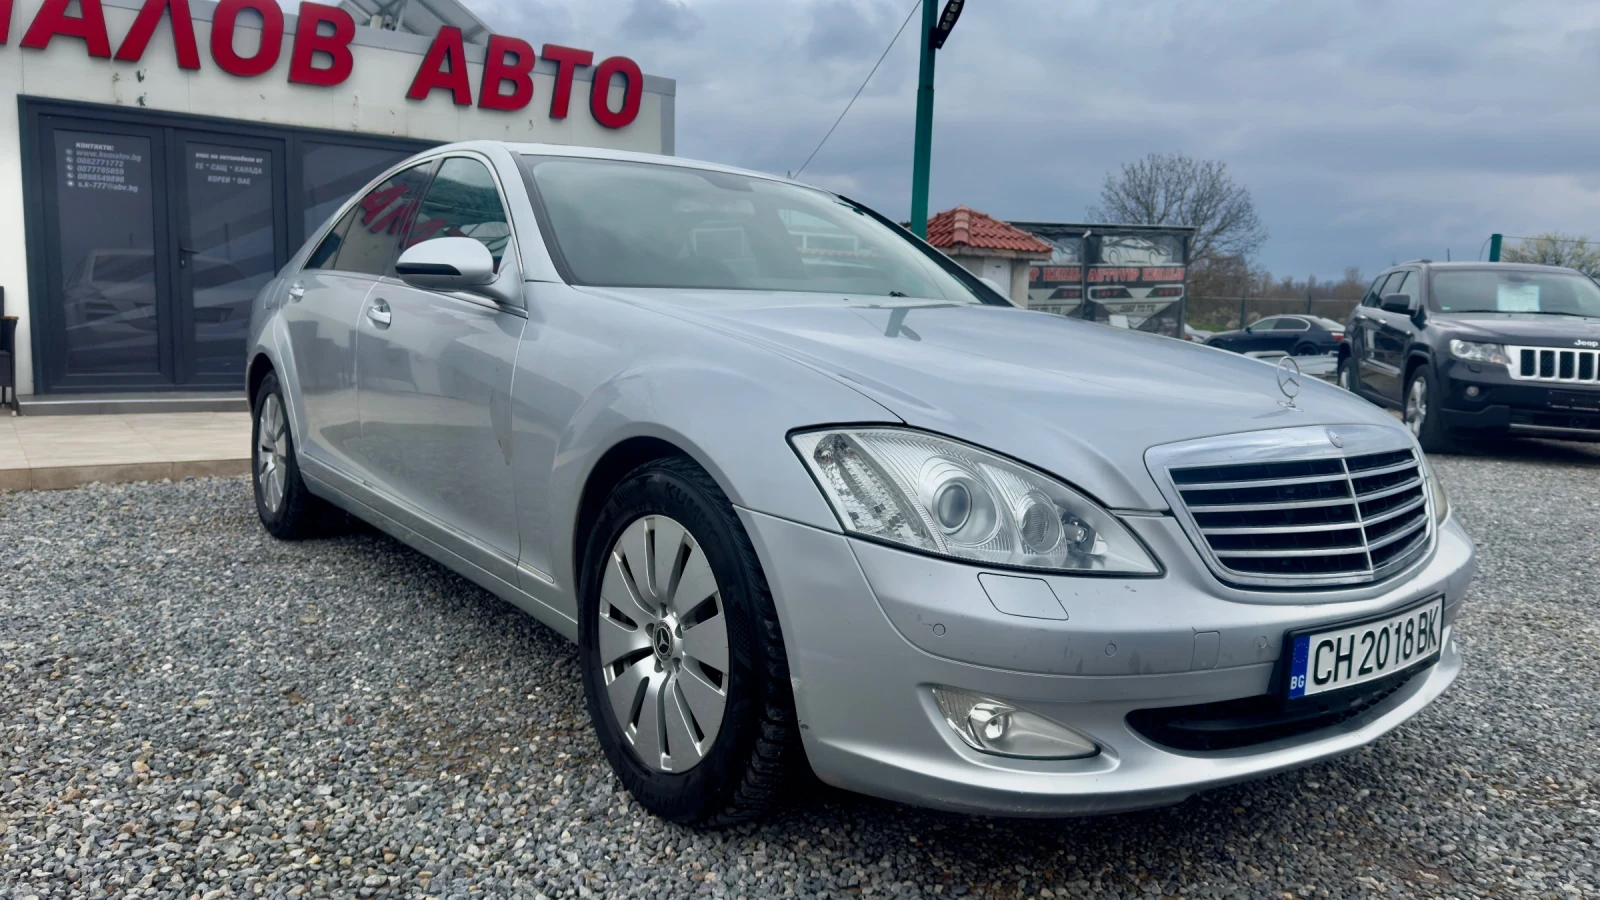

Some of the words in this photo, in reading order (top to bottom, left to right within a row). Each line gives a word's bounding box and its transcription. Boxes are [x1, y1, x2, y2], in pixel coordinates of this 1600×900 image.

[405, 24, 644, 129] АВТО
[210, 163, 228, 172] САЩ
[234, 165, 263, 175] КАНАДА
[1573, 339, 1599, 348] Jeep
[1290, 674, 1306, 690] BG
